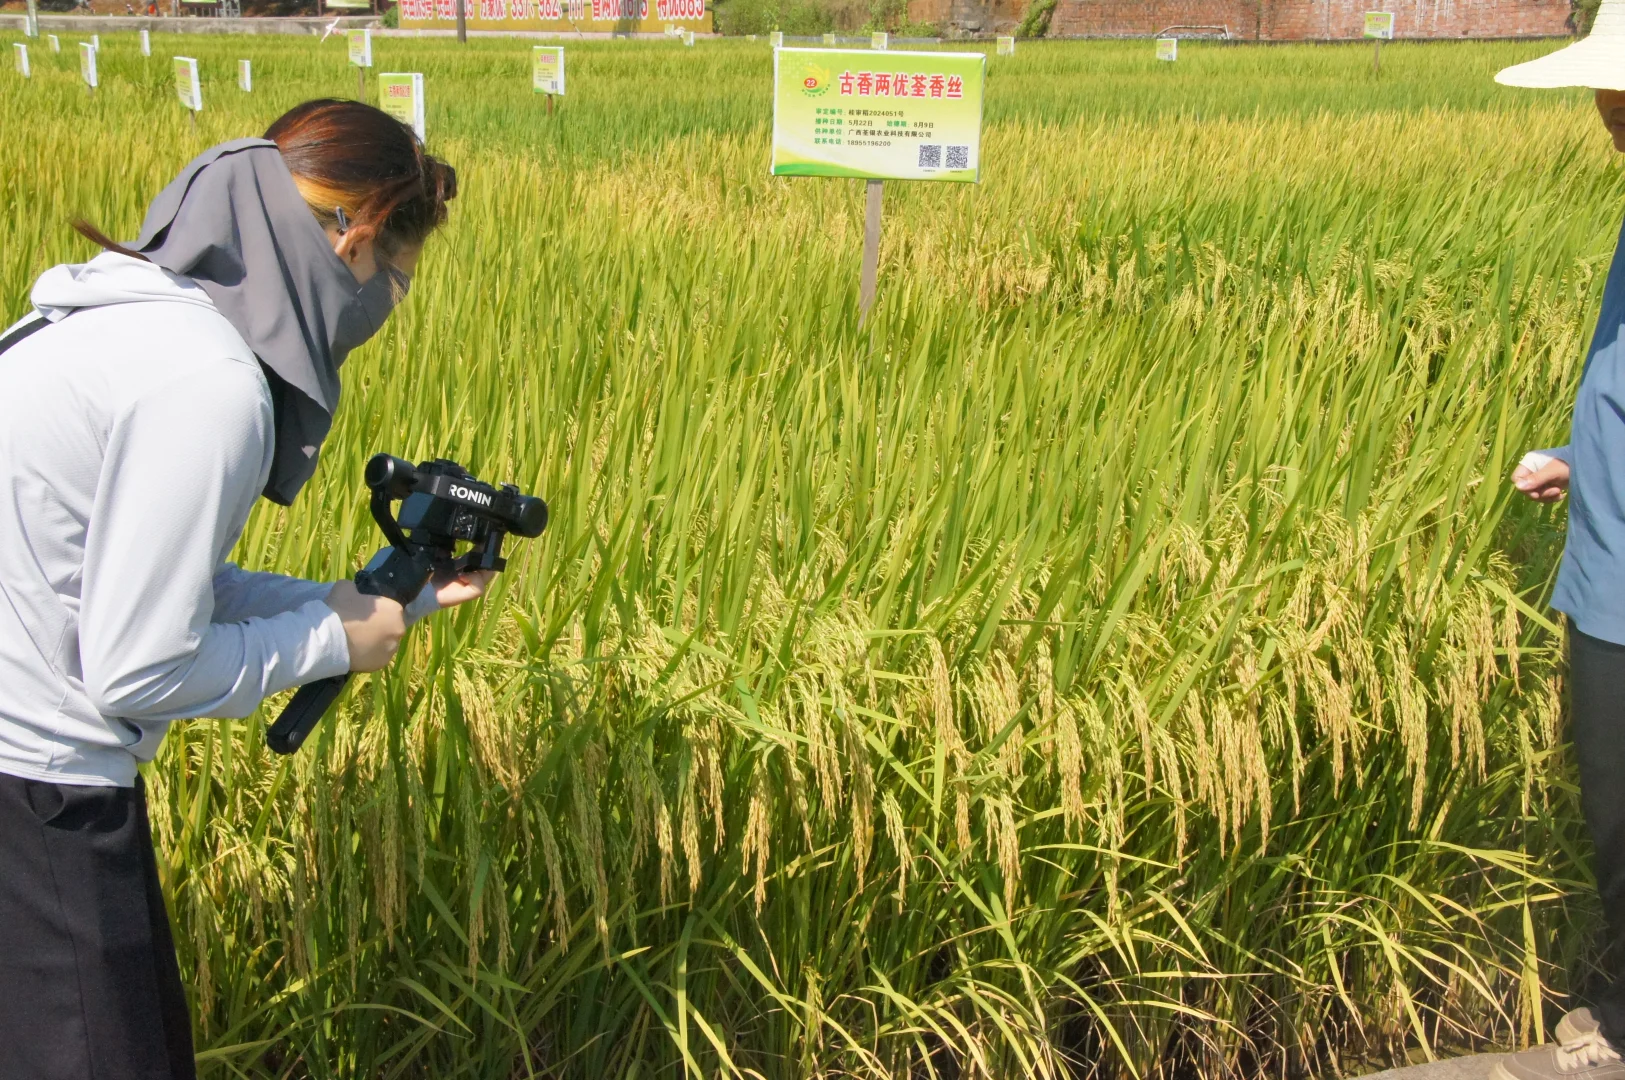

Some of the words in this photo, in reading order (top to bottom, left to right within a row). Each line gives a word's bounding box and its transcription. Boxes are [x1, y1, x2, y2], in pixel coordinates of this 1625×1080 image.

[806, 79, 816, 87] 22
[839, 71, 963, 99] 古香两优荃香丝
[448, 484, 492, 507] RONIN
